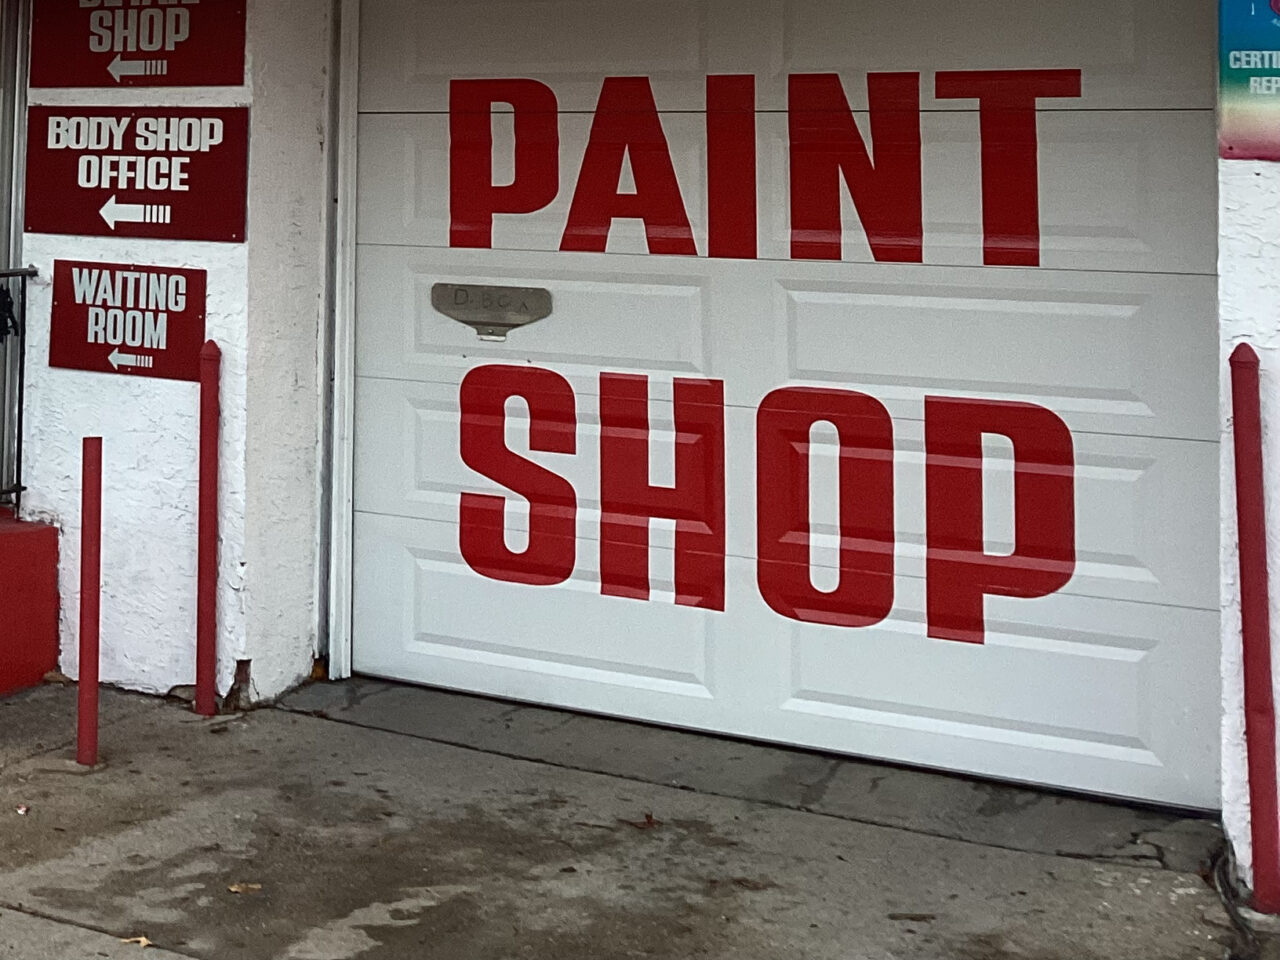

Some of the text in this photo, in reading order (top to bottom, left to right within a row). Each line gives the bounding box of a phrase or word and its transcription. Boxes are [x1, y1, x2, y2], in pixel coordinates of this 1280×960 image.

[89, 7, 190, 53] SHOP
[47, 116, 224, 152] BODY SHOP
[77, 155, 190, 191] OFFICE
[449, 69, 1082, 267] PAINT
[72, 267, 187, 312] WAITING
[87, 308, 167, 351] ROOM
[459, 363, 1077, 645] SHOP
